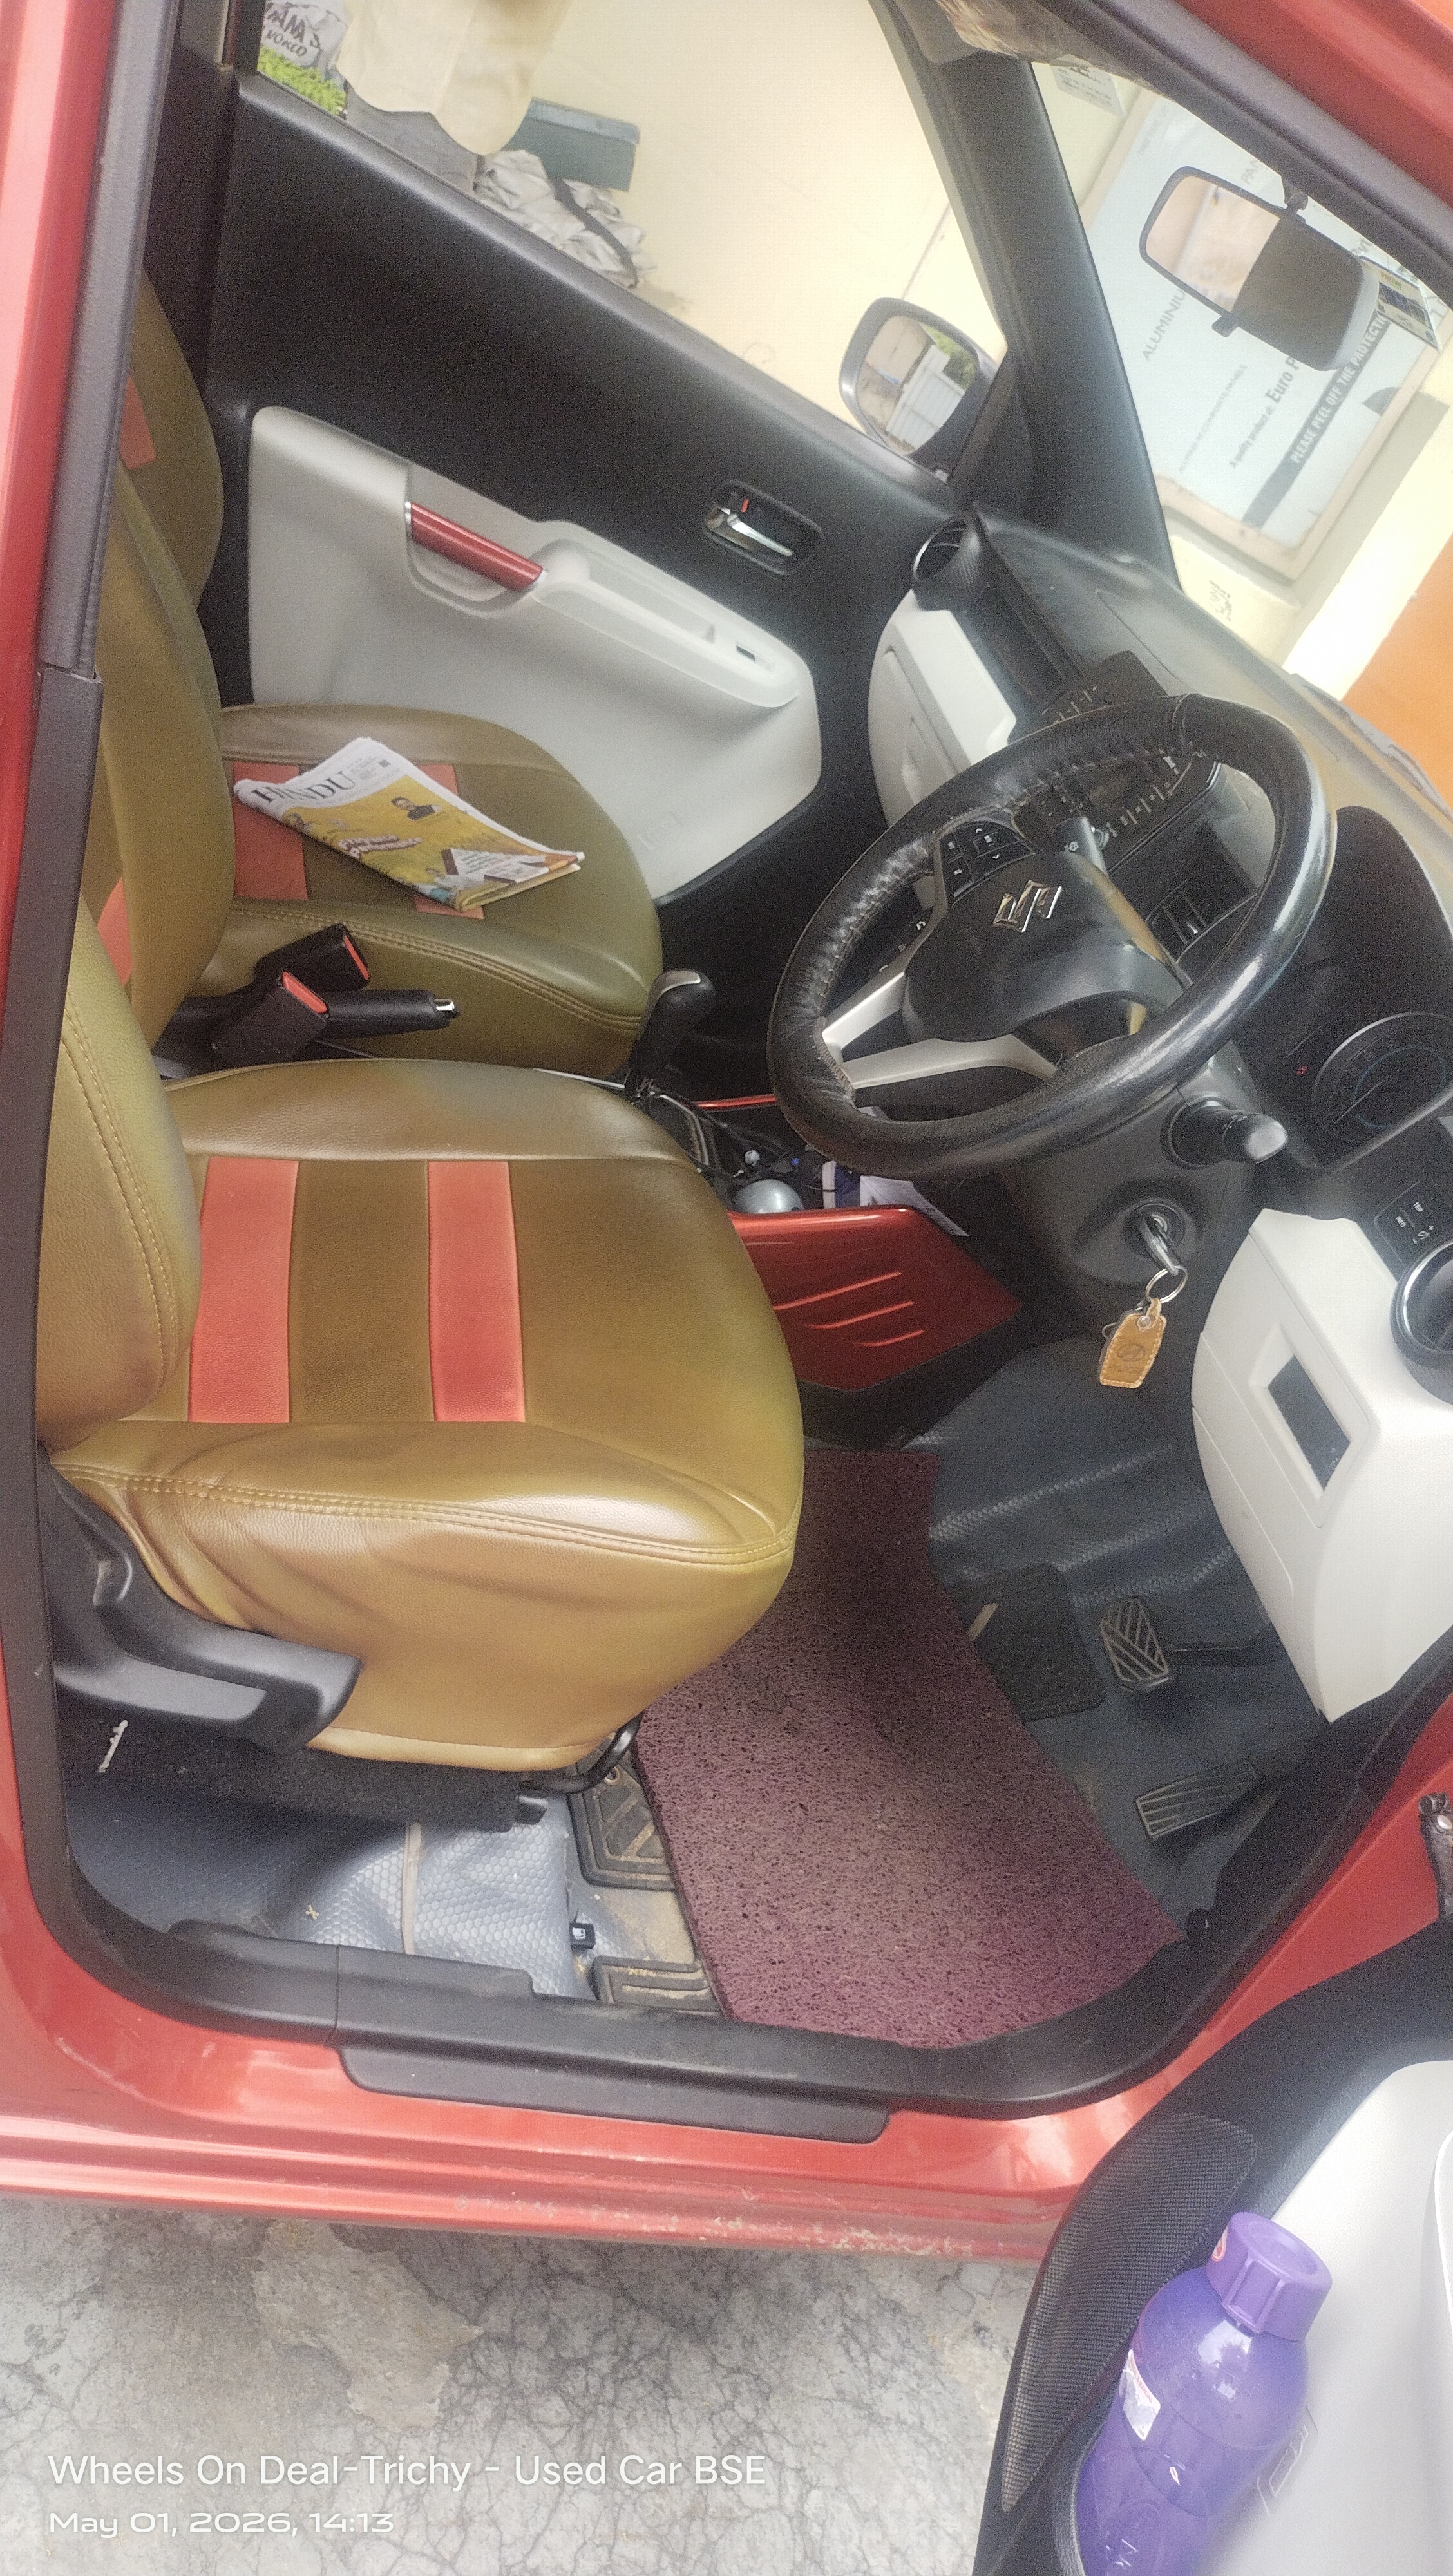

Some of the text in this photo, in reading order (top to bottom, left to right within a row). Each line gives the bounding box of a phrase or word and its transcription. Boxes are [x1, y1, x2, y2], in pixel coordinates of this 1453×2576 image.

[1264, 371, 1294, 403] Euro
[1290, 427, 1317, 464] PLEASE
[1315, 406, 1332, 430] PEEL
[1325, 386, 1343, 406] OFF
[1337, 363, 1356, 387] THE
